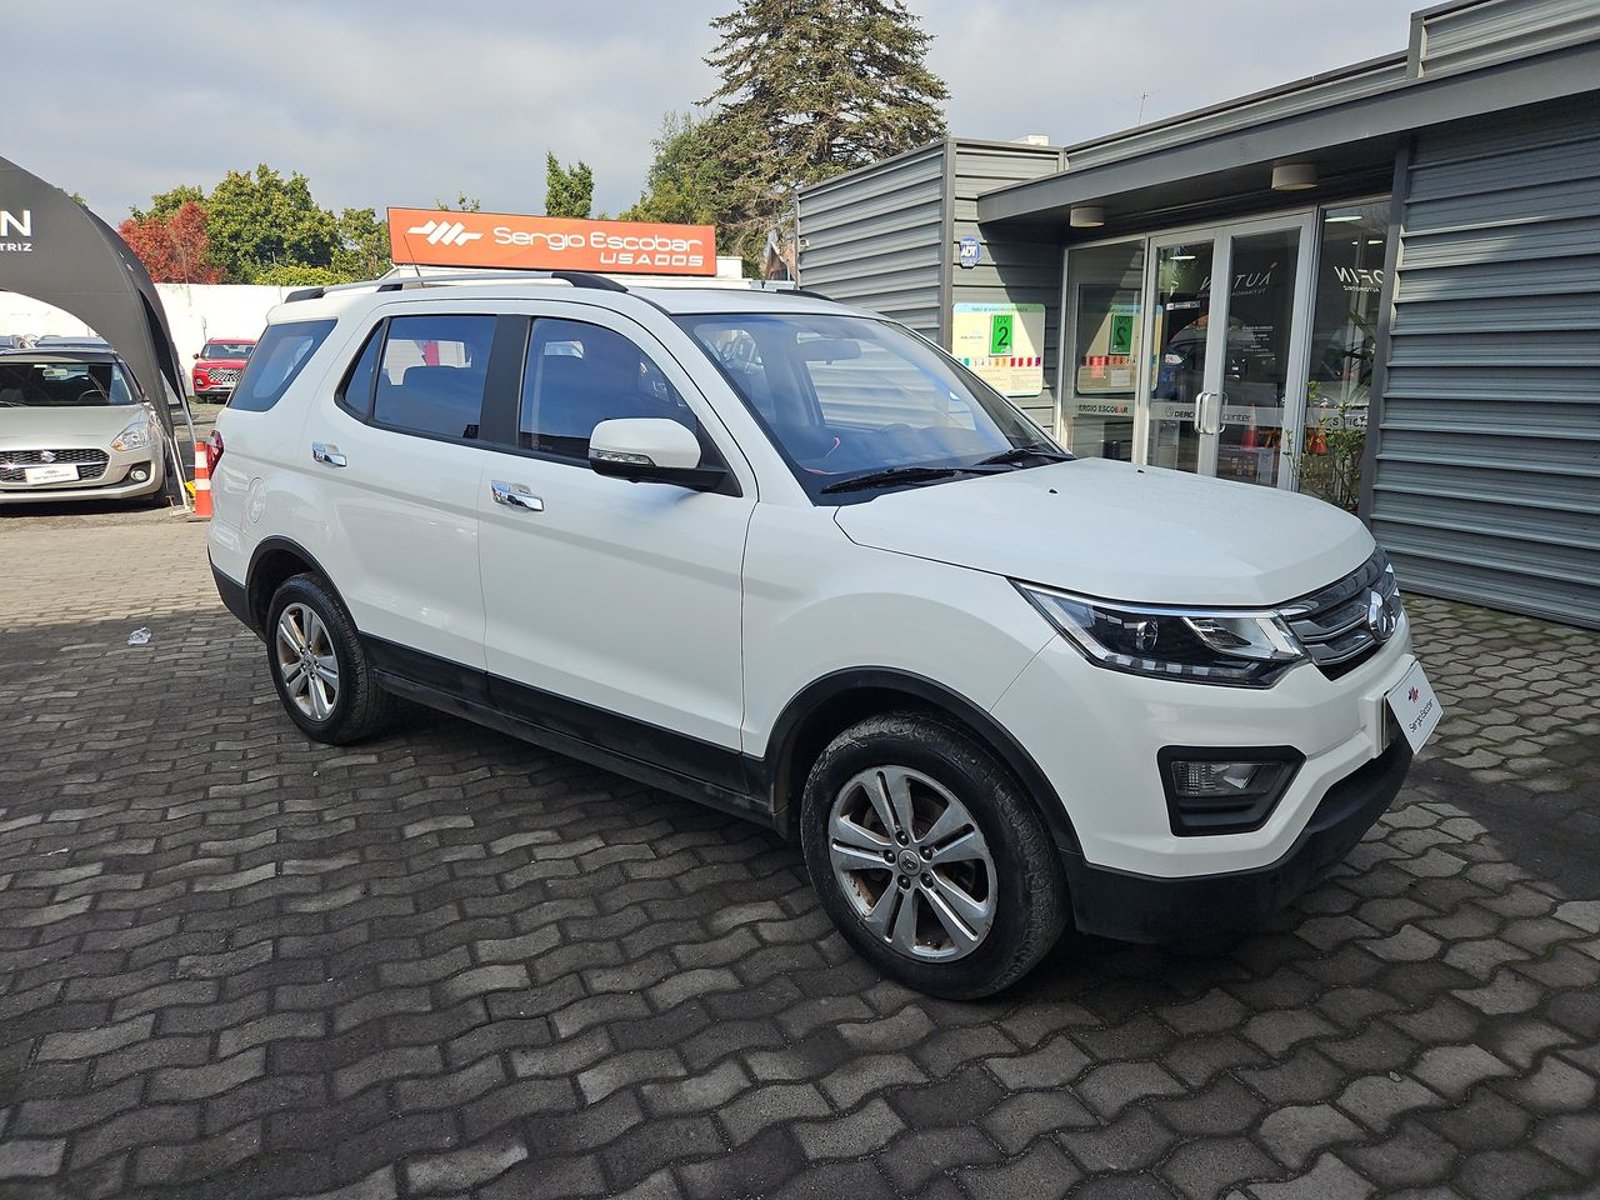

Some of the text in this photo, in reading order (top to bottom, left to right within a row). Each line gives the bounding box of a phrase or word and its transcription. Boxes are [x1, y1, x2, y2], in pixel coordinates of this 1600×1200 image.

[493, 226, 703, 252] Sergio Escobar
[600, 252, 704, 266] USADOS
[997, 326, 1009, 346] 2
[1077, 404, 1097, 413] ERGIO
